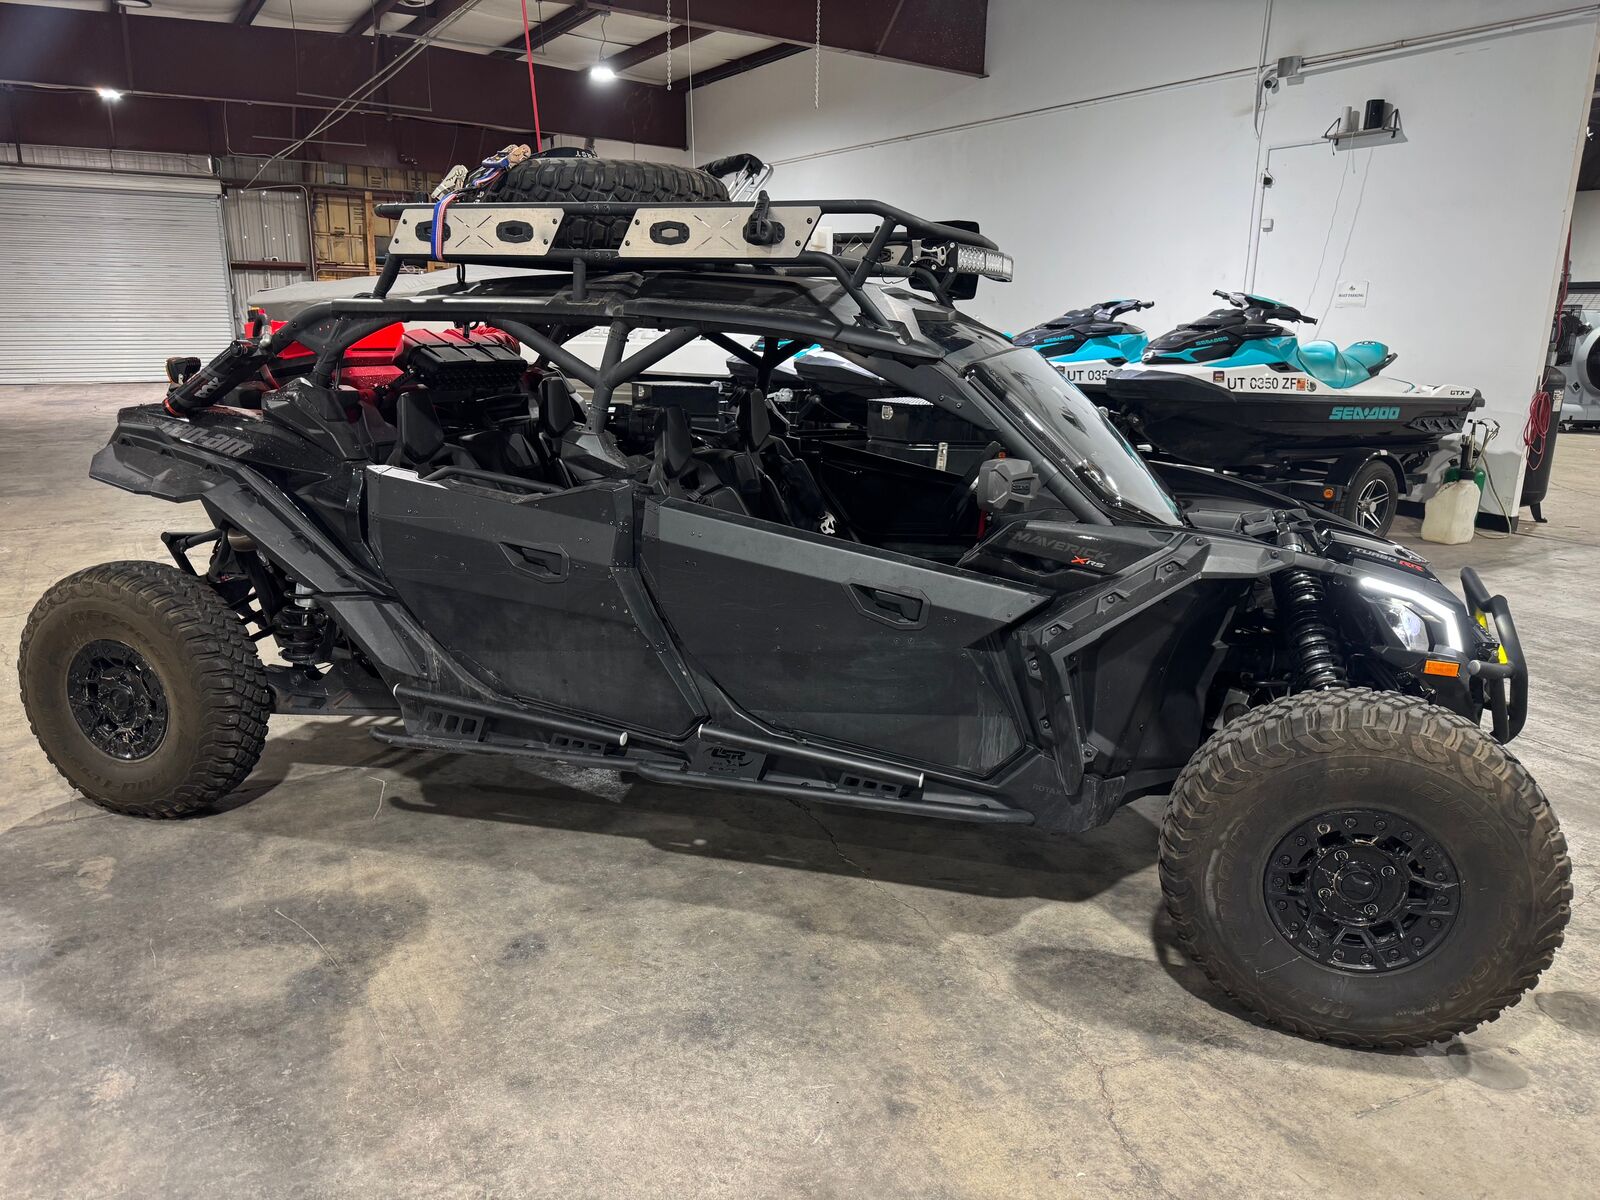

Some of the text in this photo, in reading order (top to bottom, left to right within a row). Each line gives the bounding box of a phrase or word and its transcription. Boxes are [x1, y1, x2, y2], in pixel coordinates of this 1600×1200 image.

[1067, 370, 1084, 381] UT
[1227, 377, 1245, 389] UT
[1250, 377, 1278, 389] 0350
[1282, 378, 1297, 389] ZF
[1012, 530, 1112, 562] MAVERICK
[1354, 547, 1397, 562] TURBO
